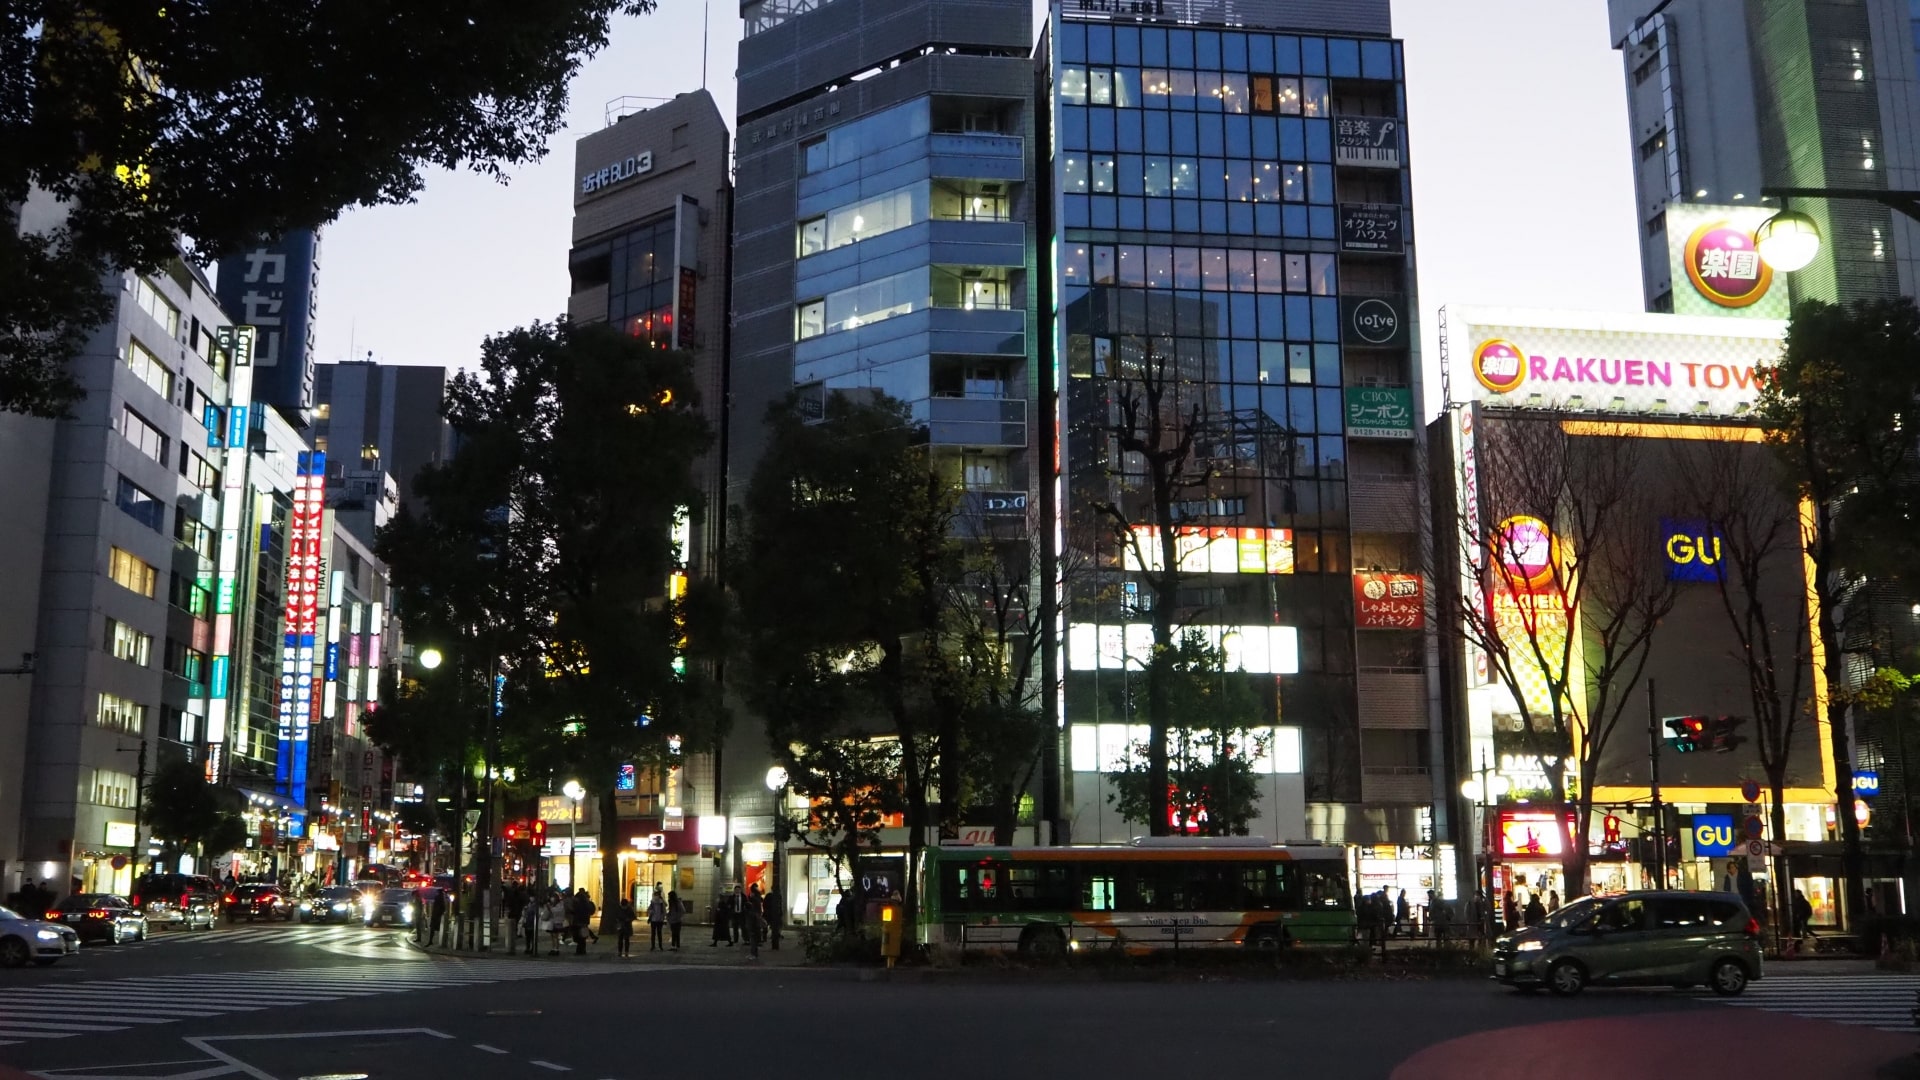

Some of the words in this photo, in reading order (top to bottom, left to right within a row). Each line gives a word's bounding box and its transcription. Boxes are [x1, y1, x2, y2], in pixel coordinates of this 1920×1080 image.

[1338, 120, 1371, 136] 音楽
[1339, 137, 1370, 147] スタジオ
[1344, 218, 1397, 231] オクターヴ
[1355, 230, 1388, 240] ハウス
[1702, 248, 1759, 280] 楽園
[243, 231, 287, 367] カゼン
[1481, 355, 1519, 375] 楽園
[1529, 355, 1671, 386] RAKUEN
[1680, 363, 1779, 393] TOW
[1361, 391, 1397, 402] CBON
[1666, 534, 1721, 564] GU
[1361, 600, 1420, 614] しゃぶしゃぶ
[1365, 614, 1417, 627] バイキング
[1857, 776, 1878, 790] GU
[1695, 824, 1733, 847] GU
